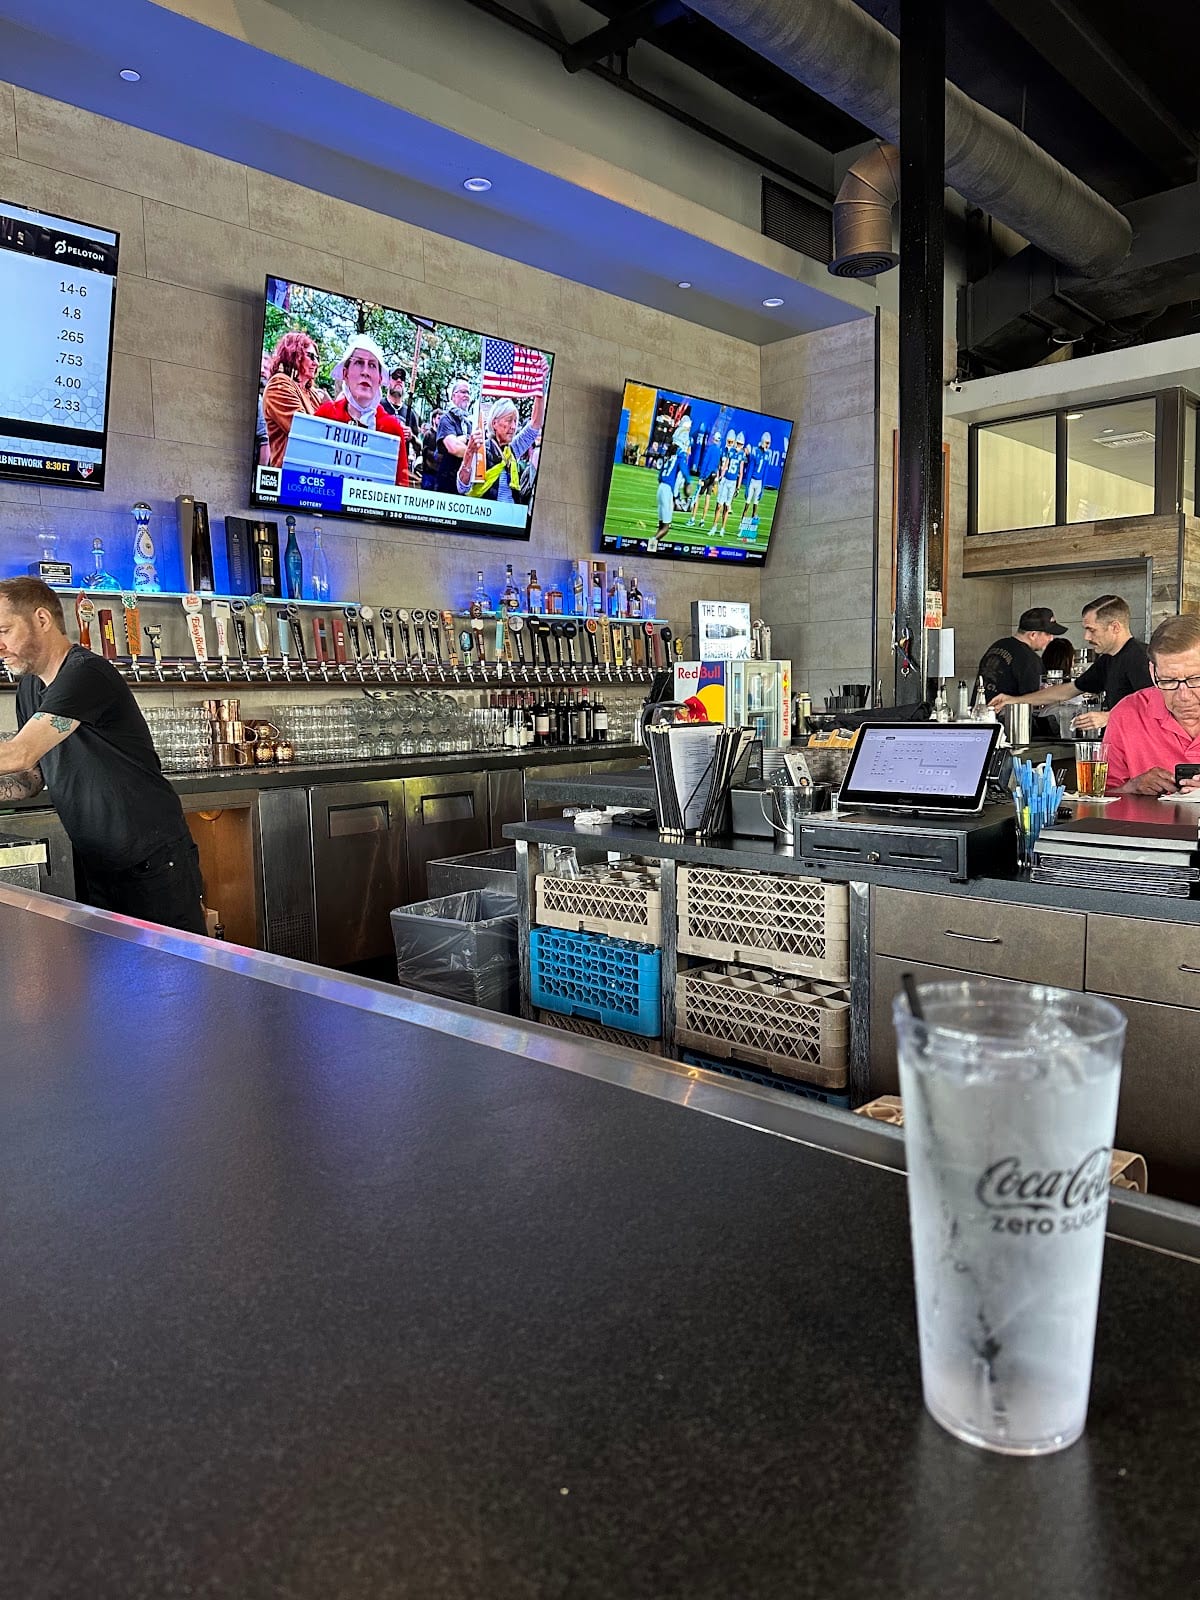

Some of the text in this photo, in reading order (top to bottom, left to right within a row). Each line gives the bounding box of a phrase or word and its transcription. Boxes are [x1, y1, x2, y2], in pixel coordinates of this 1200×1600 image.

[68, 246, 104, 262] PELOTON
[59, 281, 88, 298] 14-6
[62, 305, 82, 320] 4.8
[57, 328, 84, 344] .265
[55, 351, 83, 367] .753
[54, 374, 82, 390] 4.00
[54, 397, 81, 412] 2.33
[325, 424, 368, 448] TRUMP
[8, 455, 43, 468] NETWORK
[45, 460, 61, 470] 8:30
[62, 463, 71, 472] ET
[334, 449, 361, 469] NOT
[261, 473, 277, 481] KCAL
[261, 480, 277, 488] NEWS
[306, 476, 325, 487] CBS
[287, 483, 336, 497] LOS ANGELES
[300, 499, 322, 508] LOTTERY
[349, 487, 492, 517] PRESIDENT TRUMP IN SCOTLAND
[702, 604, 715, 617] THE
[717, 605, 727, 618] OG
[678, 665, 721, 679] Red Bull
[991, 1215, 1054, 1236] zero
